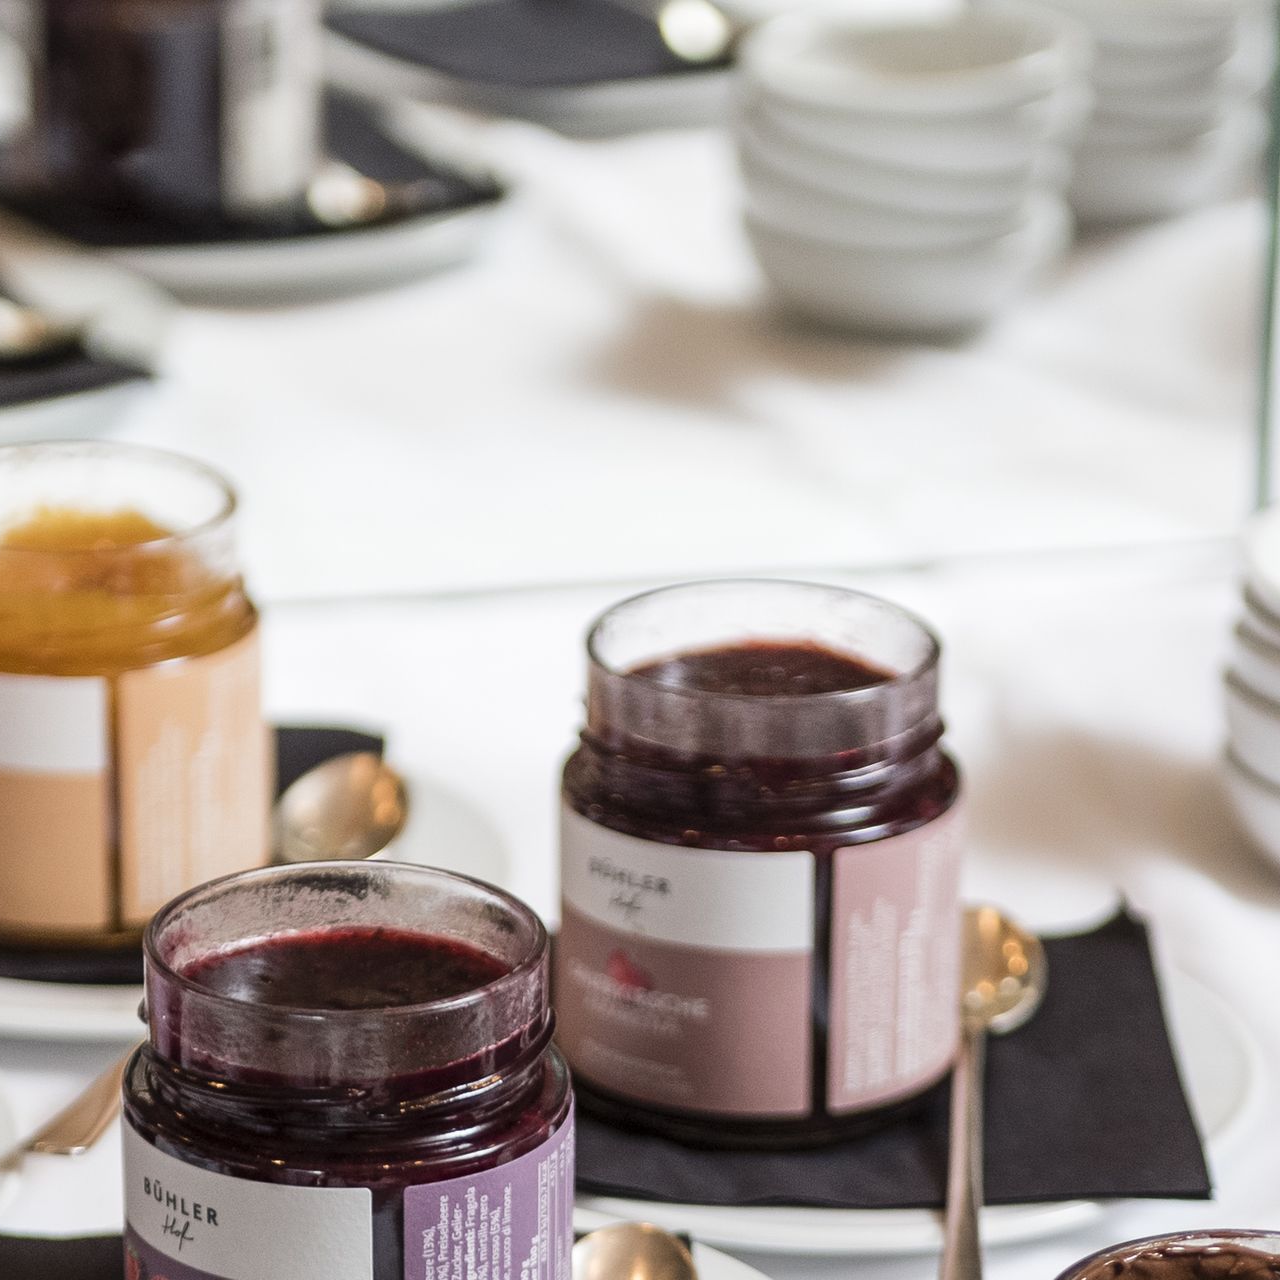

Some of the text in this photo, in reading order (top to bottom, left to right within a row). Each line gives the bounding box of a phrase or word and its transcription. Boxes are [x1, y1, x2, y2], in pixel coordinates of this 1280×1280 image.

[143, 1176, 219, 1227] BÜHLER
[465, 1186, 478, 1227] Fragola
[479, 1195, 488, 1220] nero
[162, 1214, 195, 1252] Hof
[437, 1195, 449, 1260] Preiselbeere
[451, 1203, 462, 1240] Gelier-
[501, 1225, 511, 1236] di
[422, 1226, 436, 1258] (13%),
[477, 1222, 488, 1260] mirtillo
[491, 1235, 500, 1265] rosso
[502, 1237, 512, 1268] succo
